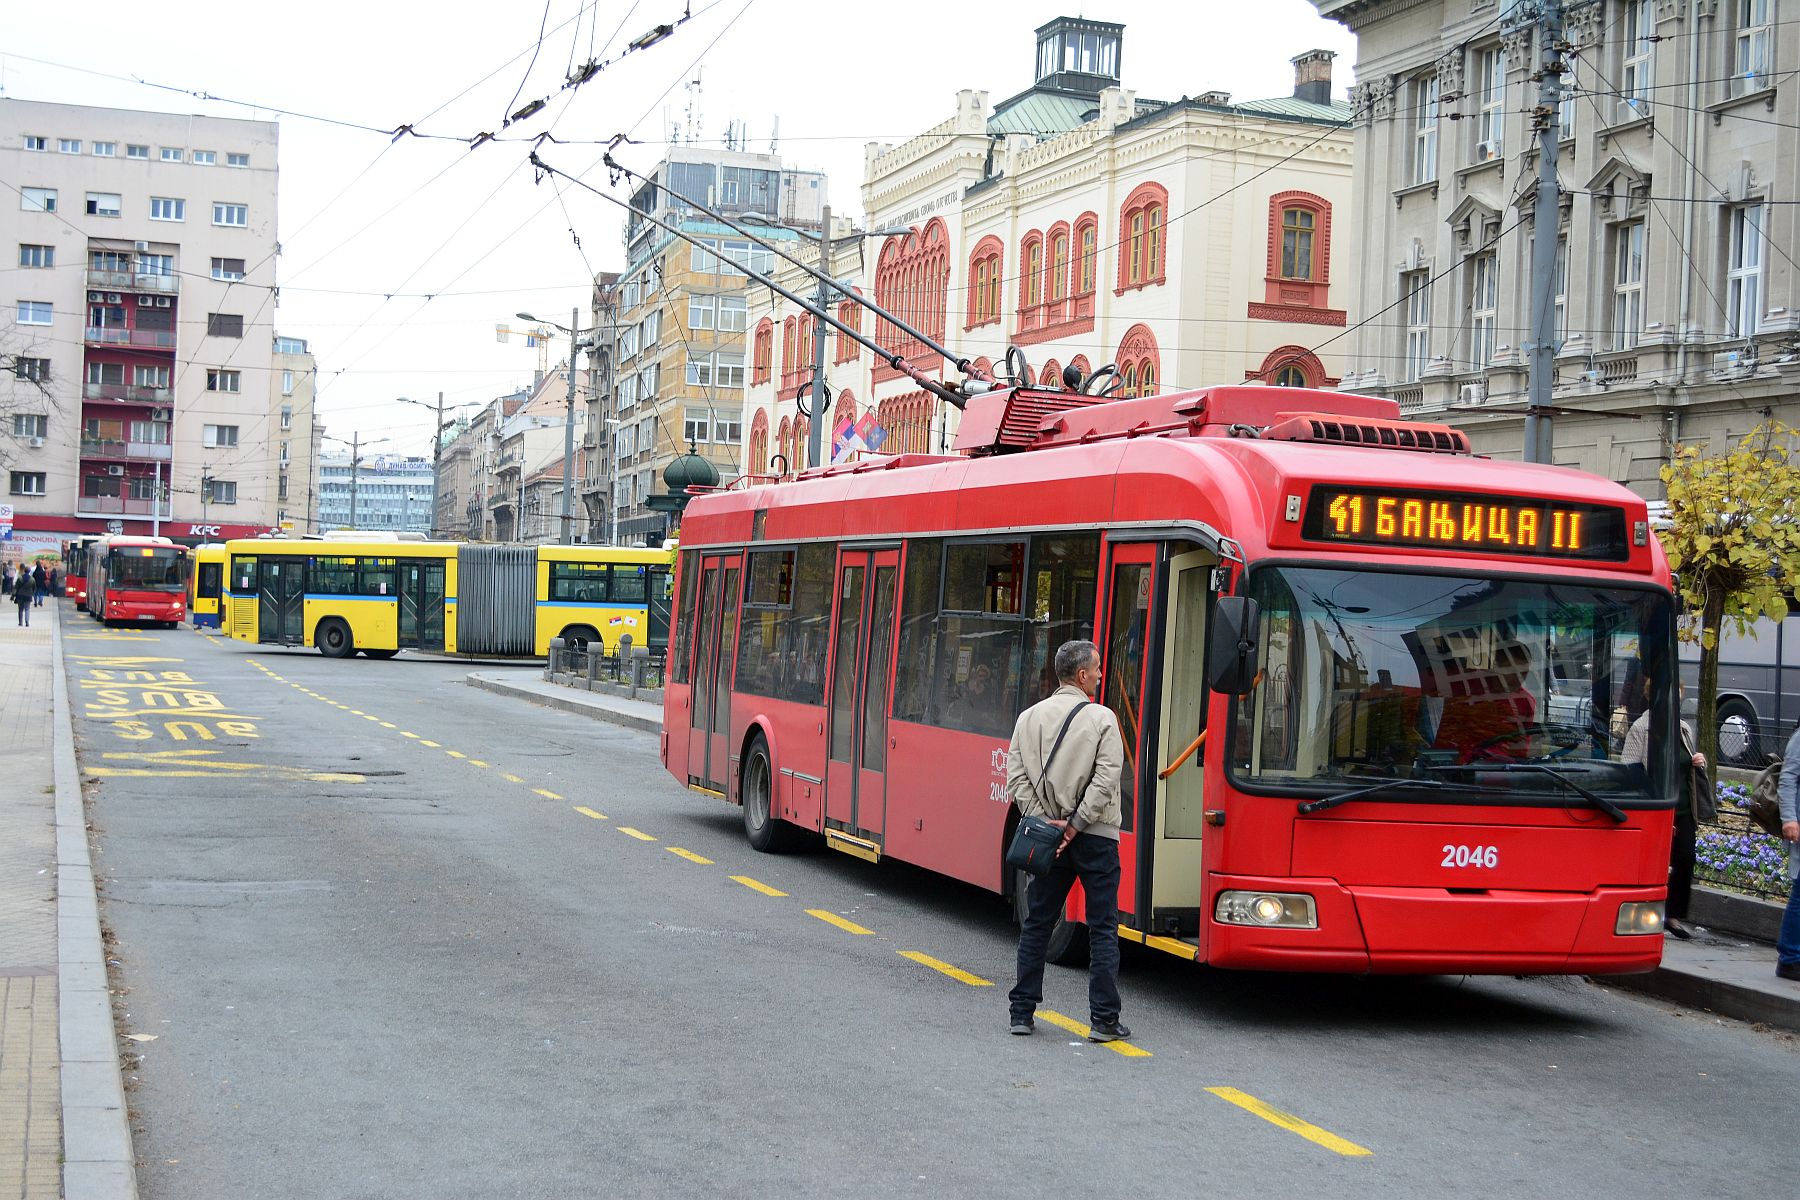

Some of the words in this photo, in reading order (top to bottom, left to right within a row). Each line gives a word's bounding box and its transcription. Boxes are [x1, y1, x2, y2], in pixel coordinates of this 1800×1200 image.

[388, 462, 407, 470] ДУНАВ
[1329, 495, 1361, 533] 41
[1376, 497, 1537, 546] БАЊИЦА
[26, 536, 58, 544] PONUDA
[189, 524, 221, 537] KFC
[89, 669, 194, 682] BUS
[96, 689, 225, 708] BUS
[111, 719, 260, 741] BUS
[990, 781, 1009, 804] 2046
[1440, 844, 1498, 869] 2046
